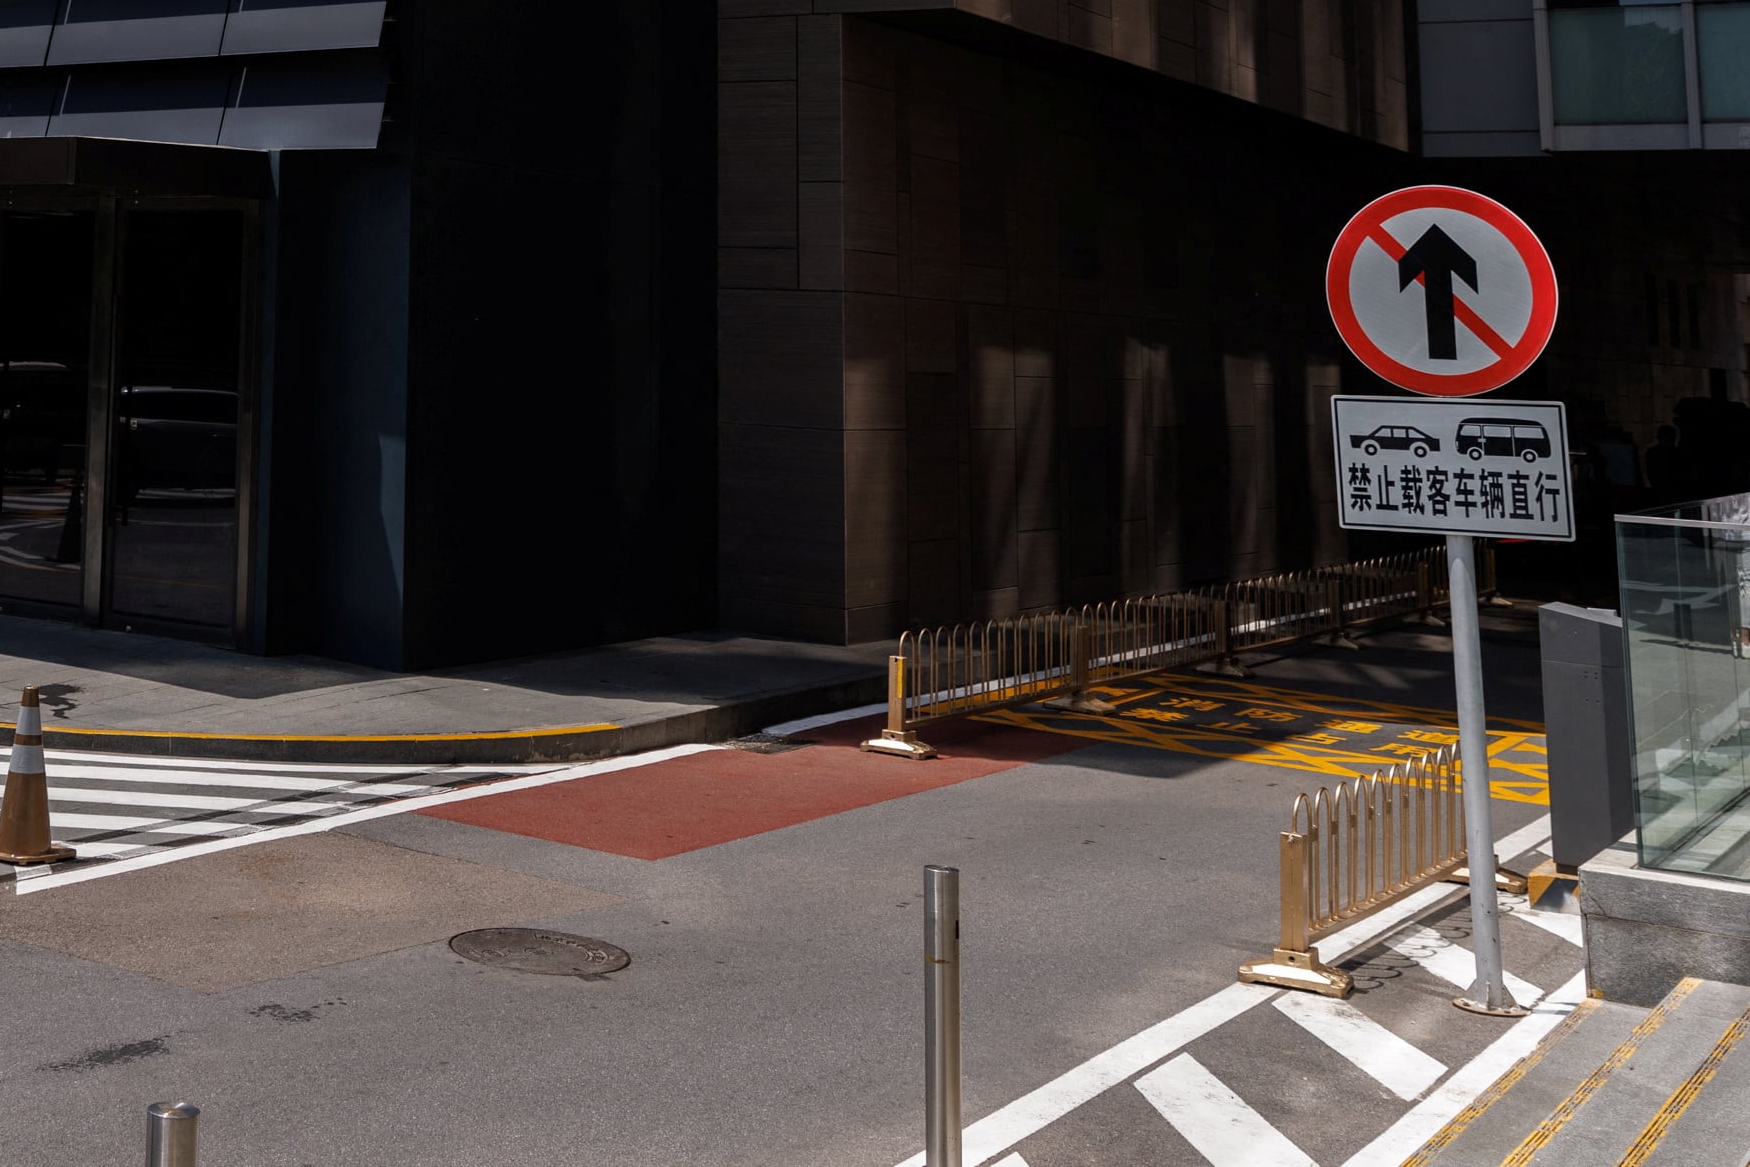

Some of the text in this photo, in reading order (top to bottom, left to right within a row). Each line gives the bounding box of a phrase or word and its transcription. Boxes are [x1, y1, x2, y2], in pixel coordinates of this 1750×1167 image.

[1348, 462, 1559, 523] 禁止载客车辆直行
